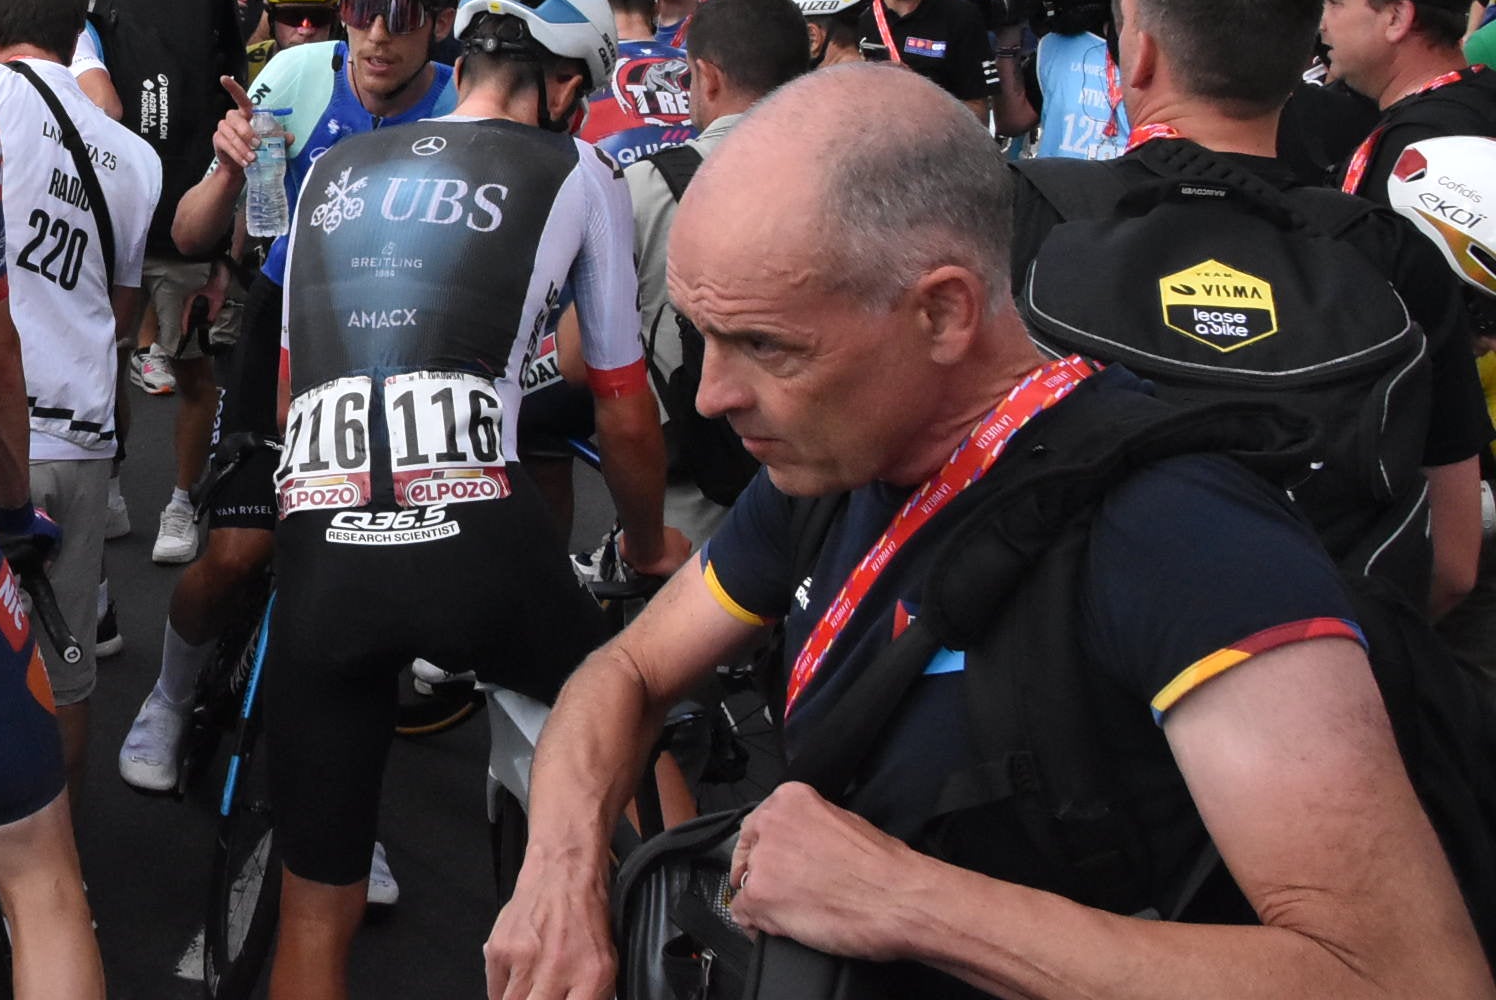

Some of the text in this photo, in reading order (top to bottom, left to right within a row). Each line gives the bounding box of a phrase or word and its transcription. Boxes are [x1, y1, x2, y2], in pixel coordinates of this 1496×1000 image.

[141, 90, 149, 134] MONDIALE
[149, 115, 157, 127] LA
[159, 87, 168, 140] DECATHLON
[101, 151, 117, 171] 25
[1438, 175, 1483, 204] Cofidis
[380, 176, 508, 233] UBS
[16, 208, 88, 291] 220
[351, 256, 423, 268] BREITLING
[1201, 284, 1263, 300] VISMA
[347, 308, 417, 329] AMACX
[1193, 308, 1247, 323] lease
[393, 387, 499, 467] 116
[216, 505, 272, 516] VAN RYSEL
[330, 508, 448, 530] Q36.5
[328, 524, 457, 543] RESEARCH SCIENTIST
